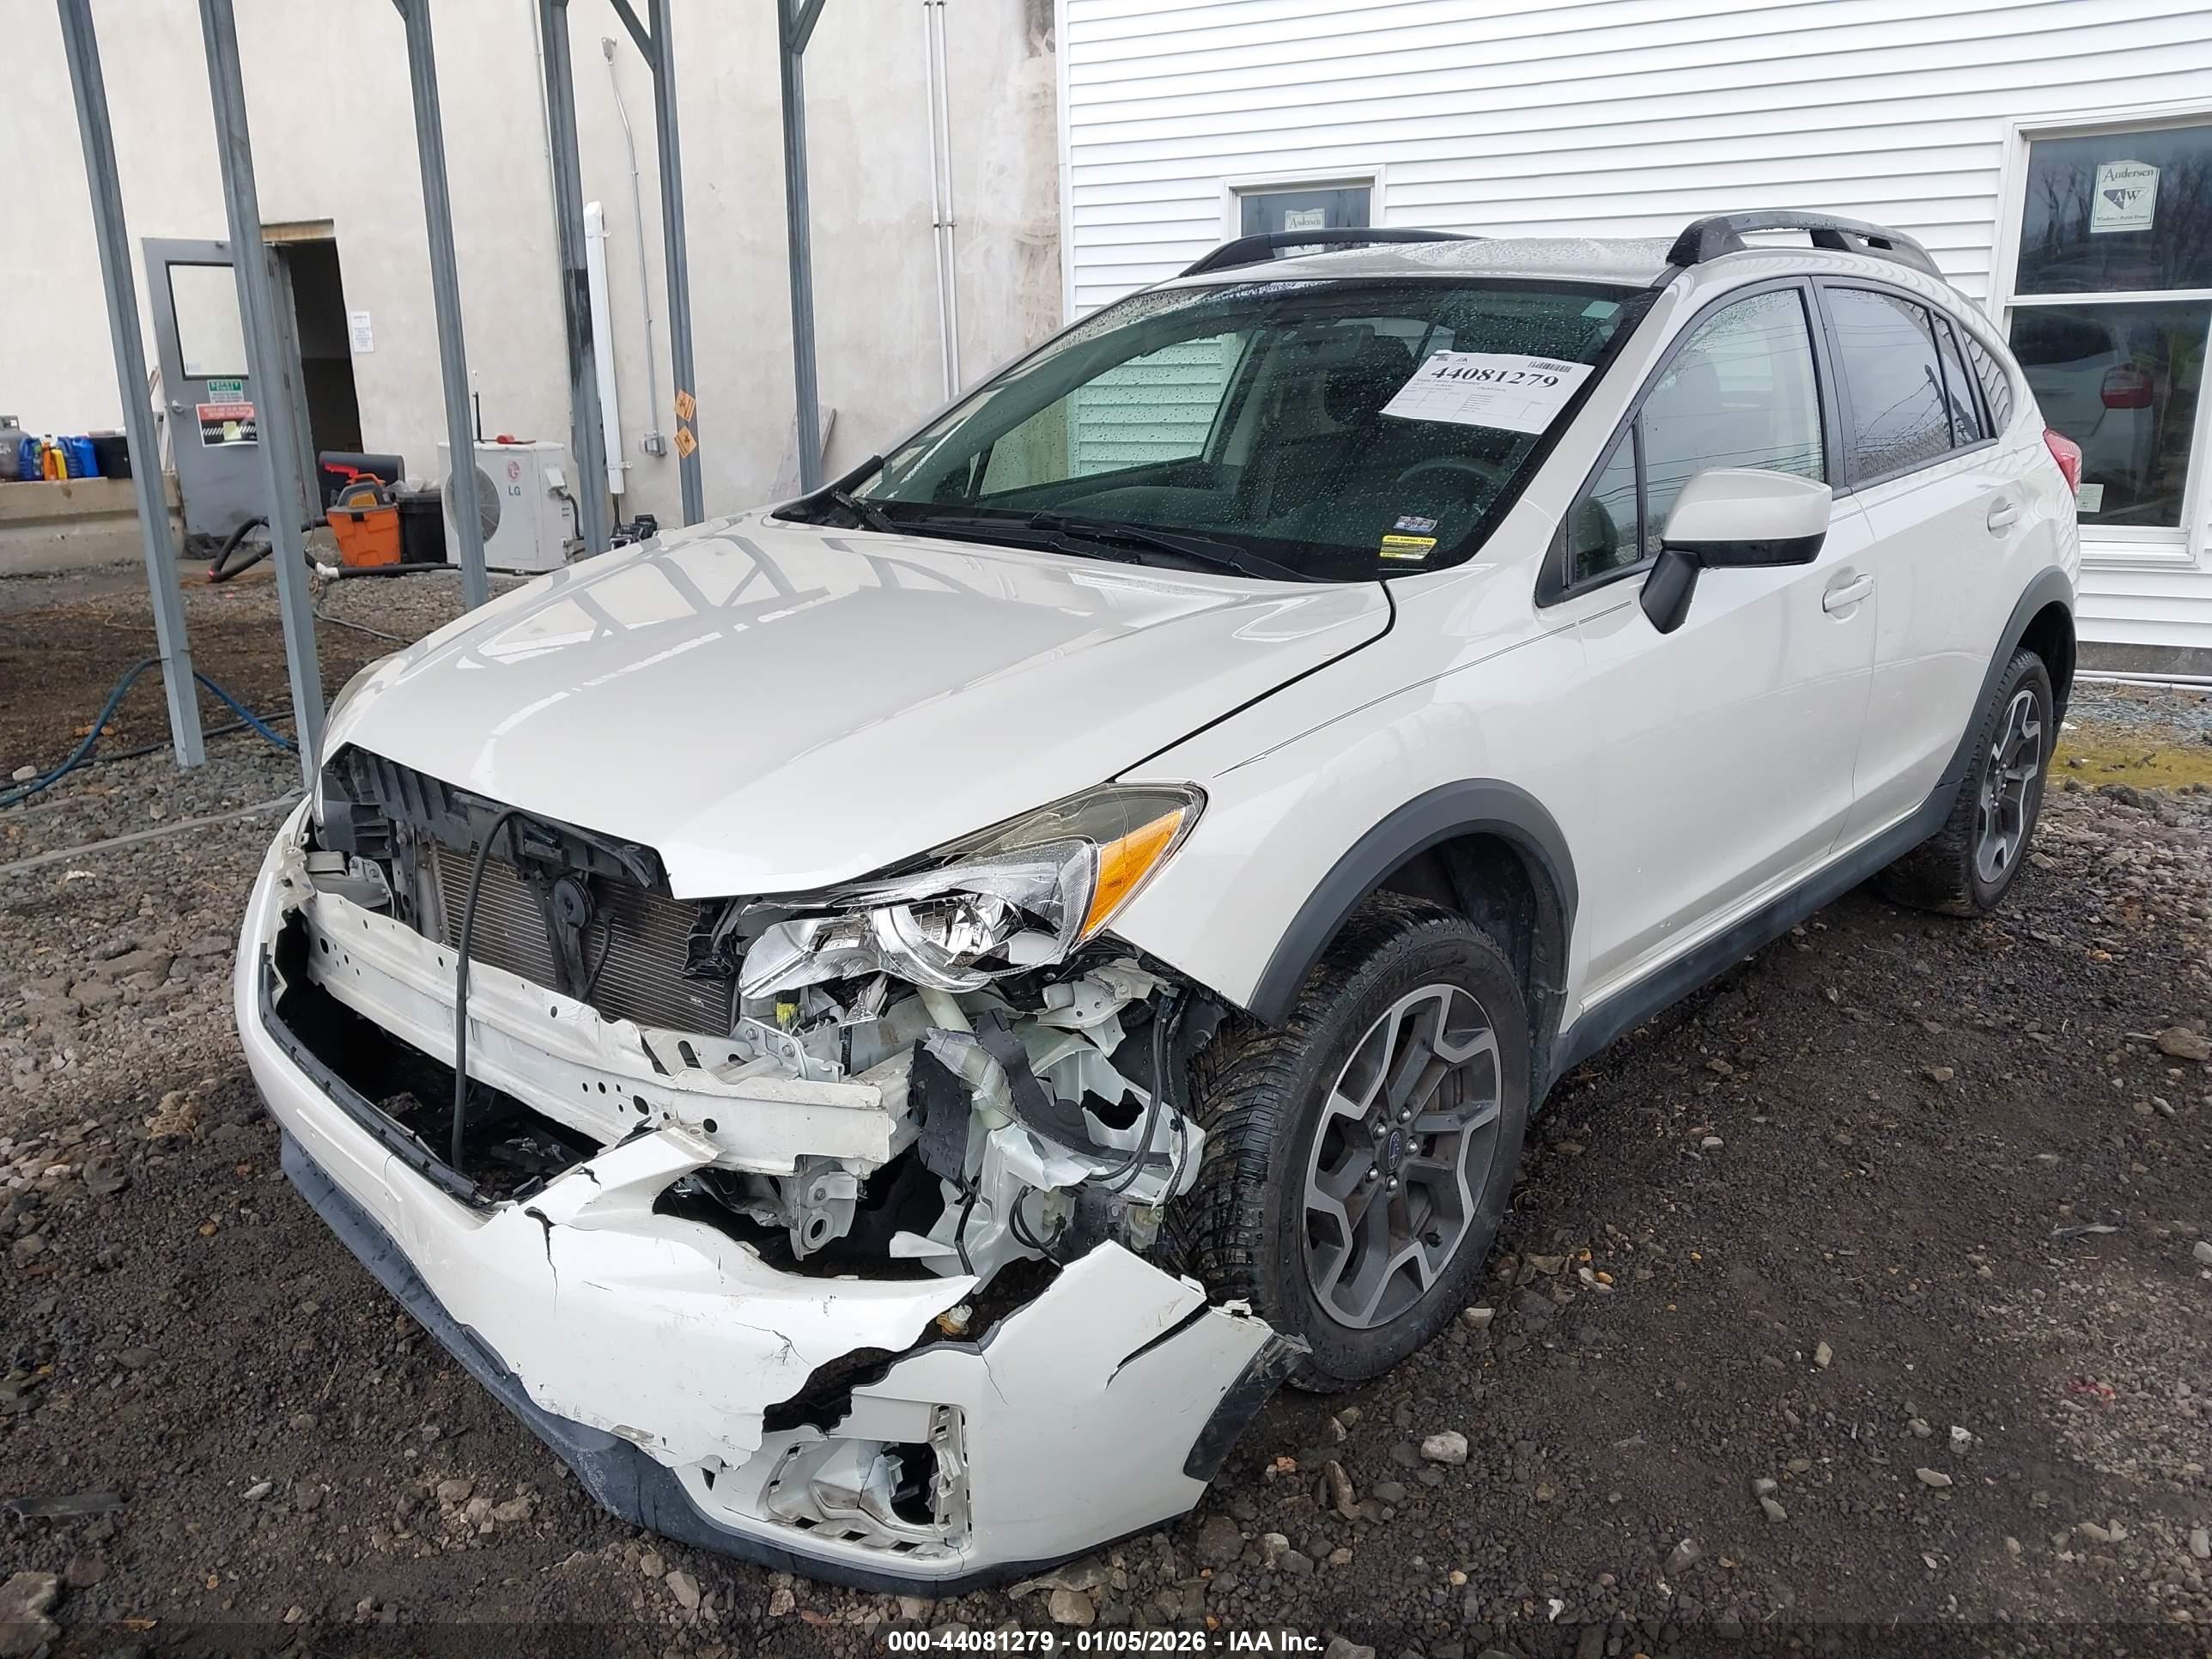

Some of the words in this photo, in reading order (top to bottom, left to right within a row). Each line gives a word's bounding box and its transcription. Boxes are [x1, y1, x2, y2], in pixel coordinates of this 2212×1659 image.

[2102, 167, 2154, 182] Andersen
[2113, 190, 2142, 203] AW
[1289, 216, 1322, 228] Andersen
[1431, 366, 1559, 388] 44081279
[507, 485, 521, 496] LG
